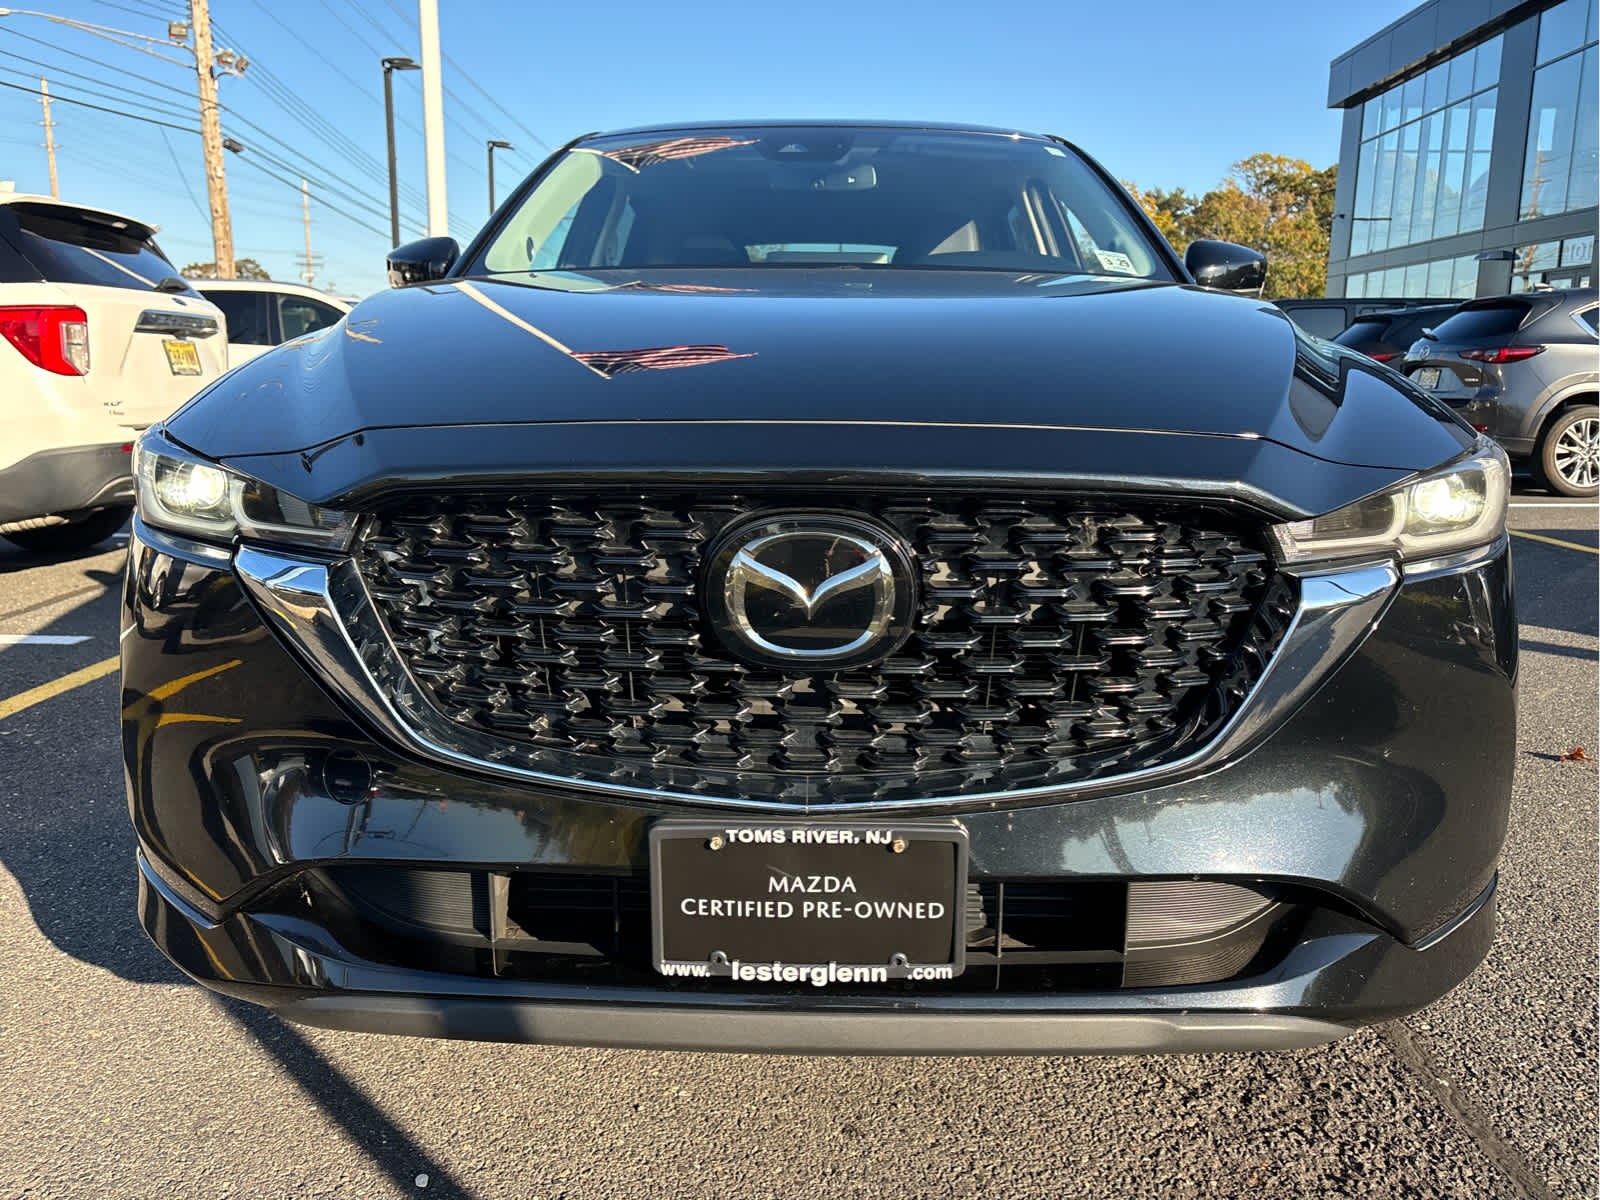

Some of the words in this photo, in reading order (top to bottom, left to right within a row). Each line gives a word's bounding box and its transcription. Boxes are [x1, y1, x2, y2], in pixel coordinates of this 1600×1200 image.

[725, 827, 786, 844] TOMS
[791, 827, 860, 846] RIVER,
[865, 828, 893, 845] NJ
[768, 875, 857, 893] MAZDA
[680, 897, 794, 919] CERTIFIED
[802, 900, 945, 920] PRE-OWNED
[660, 962, 711, 977] www.
[731, 960, 888, 987] lesterglenn
[907, 964, 953, 980] .com
